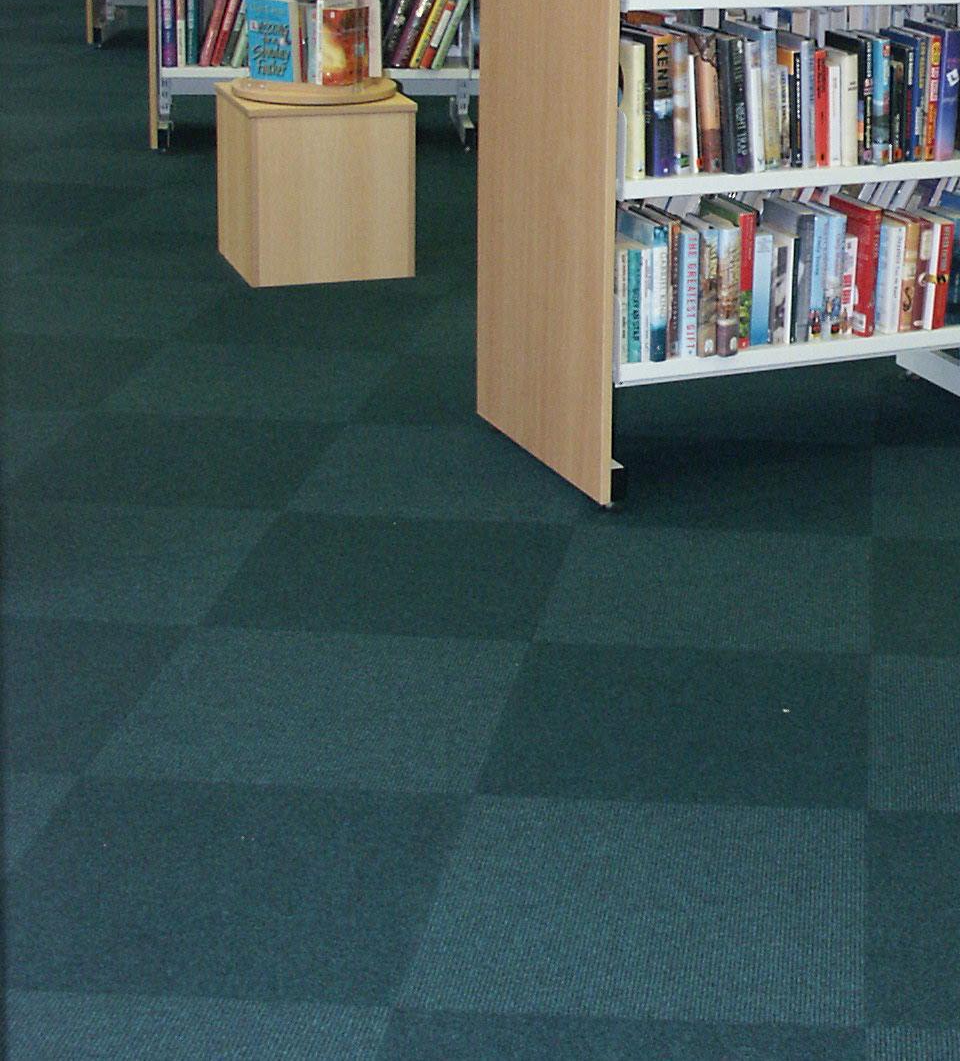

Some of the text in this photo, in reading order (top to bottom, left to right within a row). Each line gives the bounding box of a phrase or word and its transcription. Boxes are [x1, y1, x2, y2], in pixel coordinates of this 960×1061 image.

[656, 44, 669, 92] KENT
[735, 103, 746, 155] NIGHT TRAP
[686, 237, 697, 348] THE GREATEST GIFT
